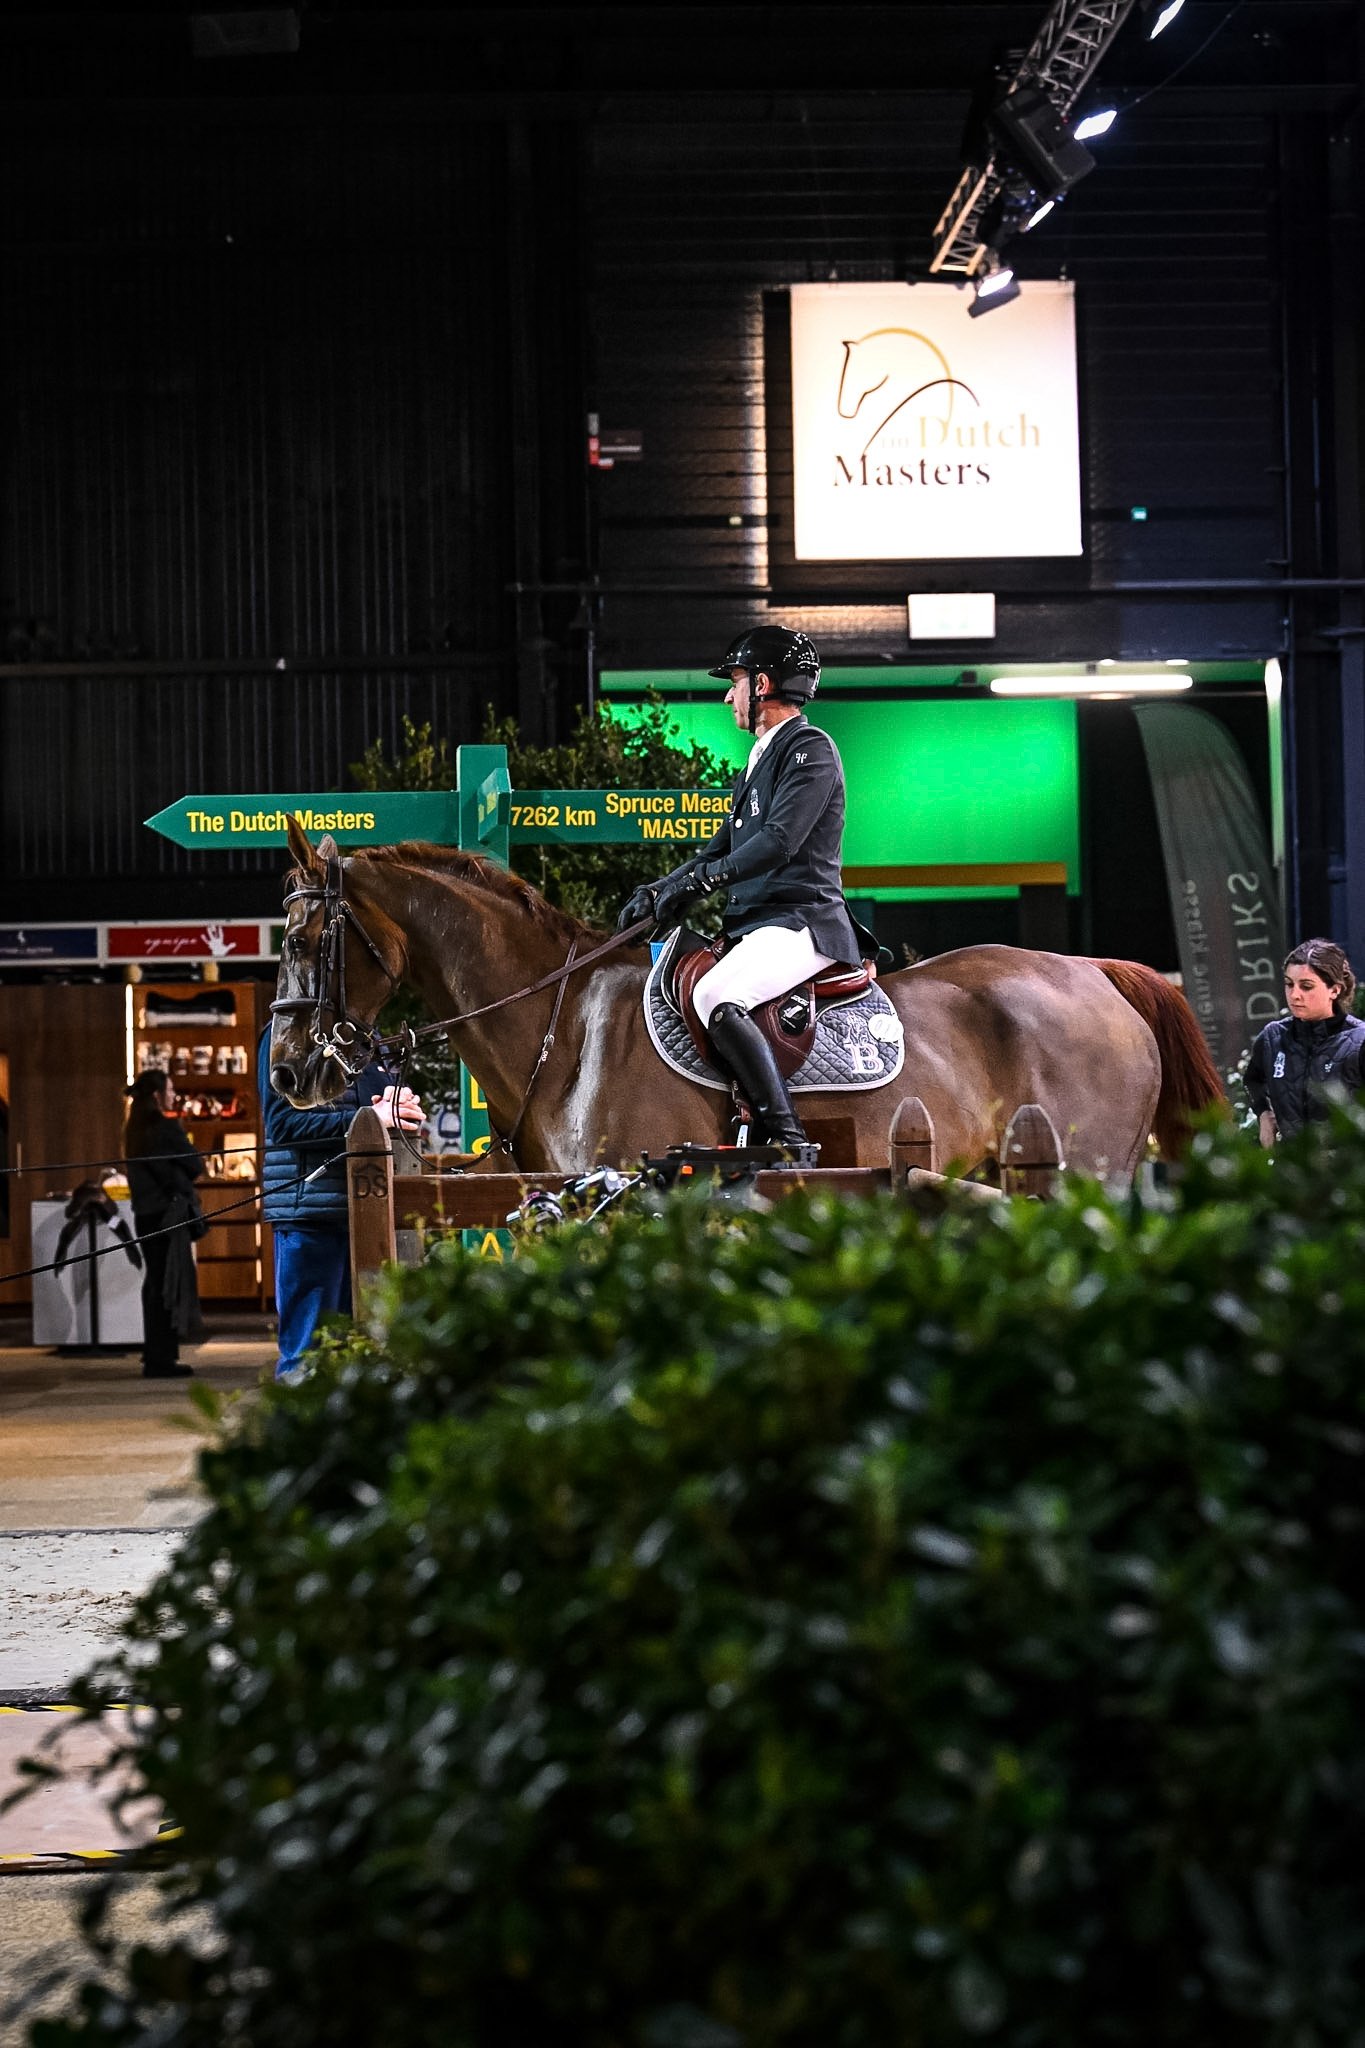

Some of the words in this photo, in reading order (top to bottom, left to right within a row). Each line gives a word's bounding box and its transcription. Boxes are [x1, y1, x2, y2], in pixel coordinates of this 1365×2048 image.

[919, 413, 1041, 449] Dutch
[833, 454, 990, 486] Masters
[511, 806, 560, 827] 7262
[566, 805, 597, 827] km
[605, 793, 670, 818] Spruce
[186, 812, 225, 833] The
[230, 810, 288, 832] Dutch
[294, 809, 375, 831] Masters
